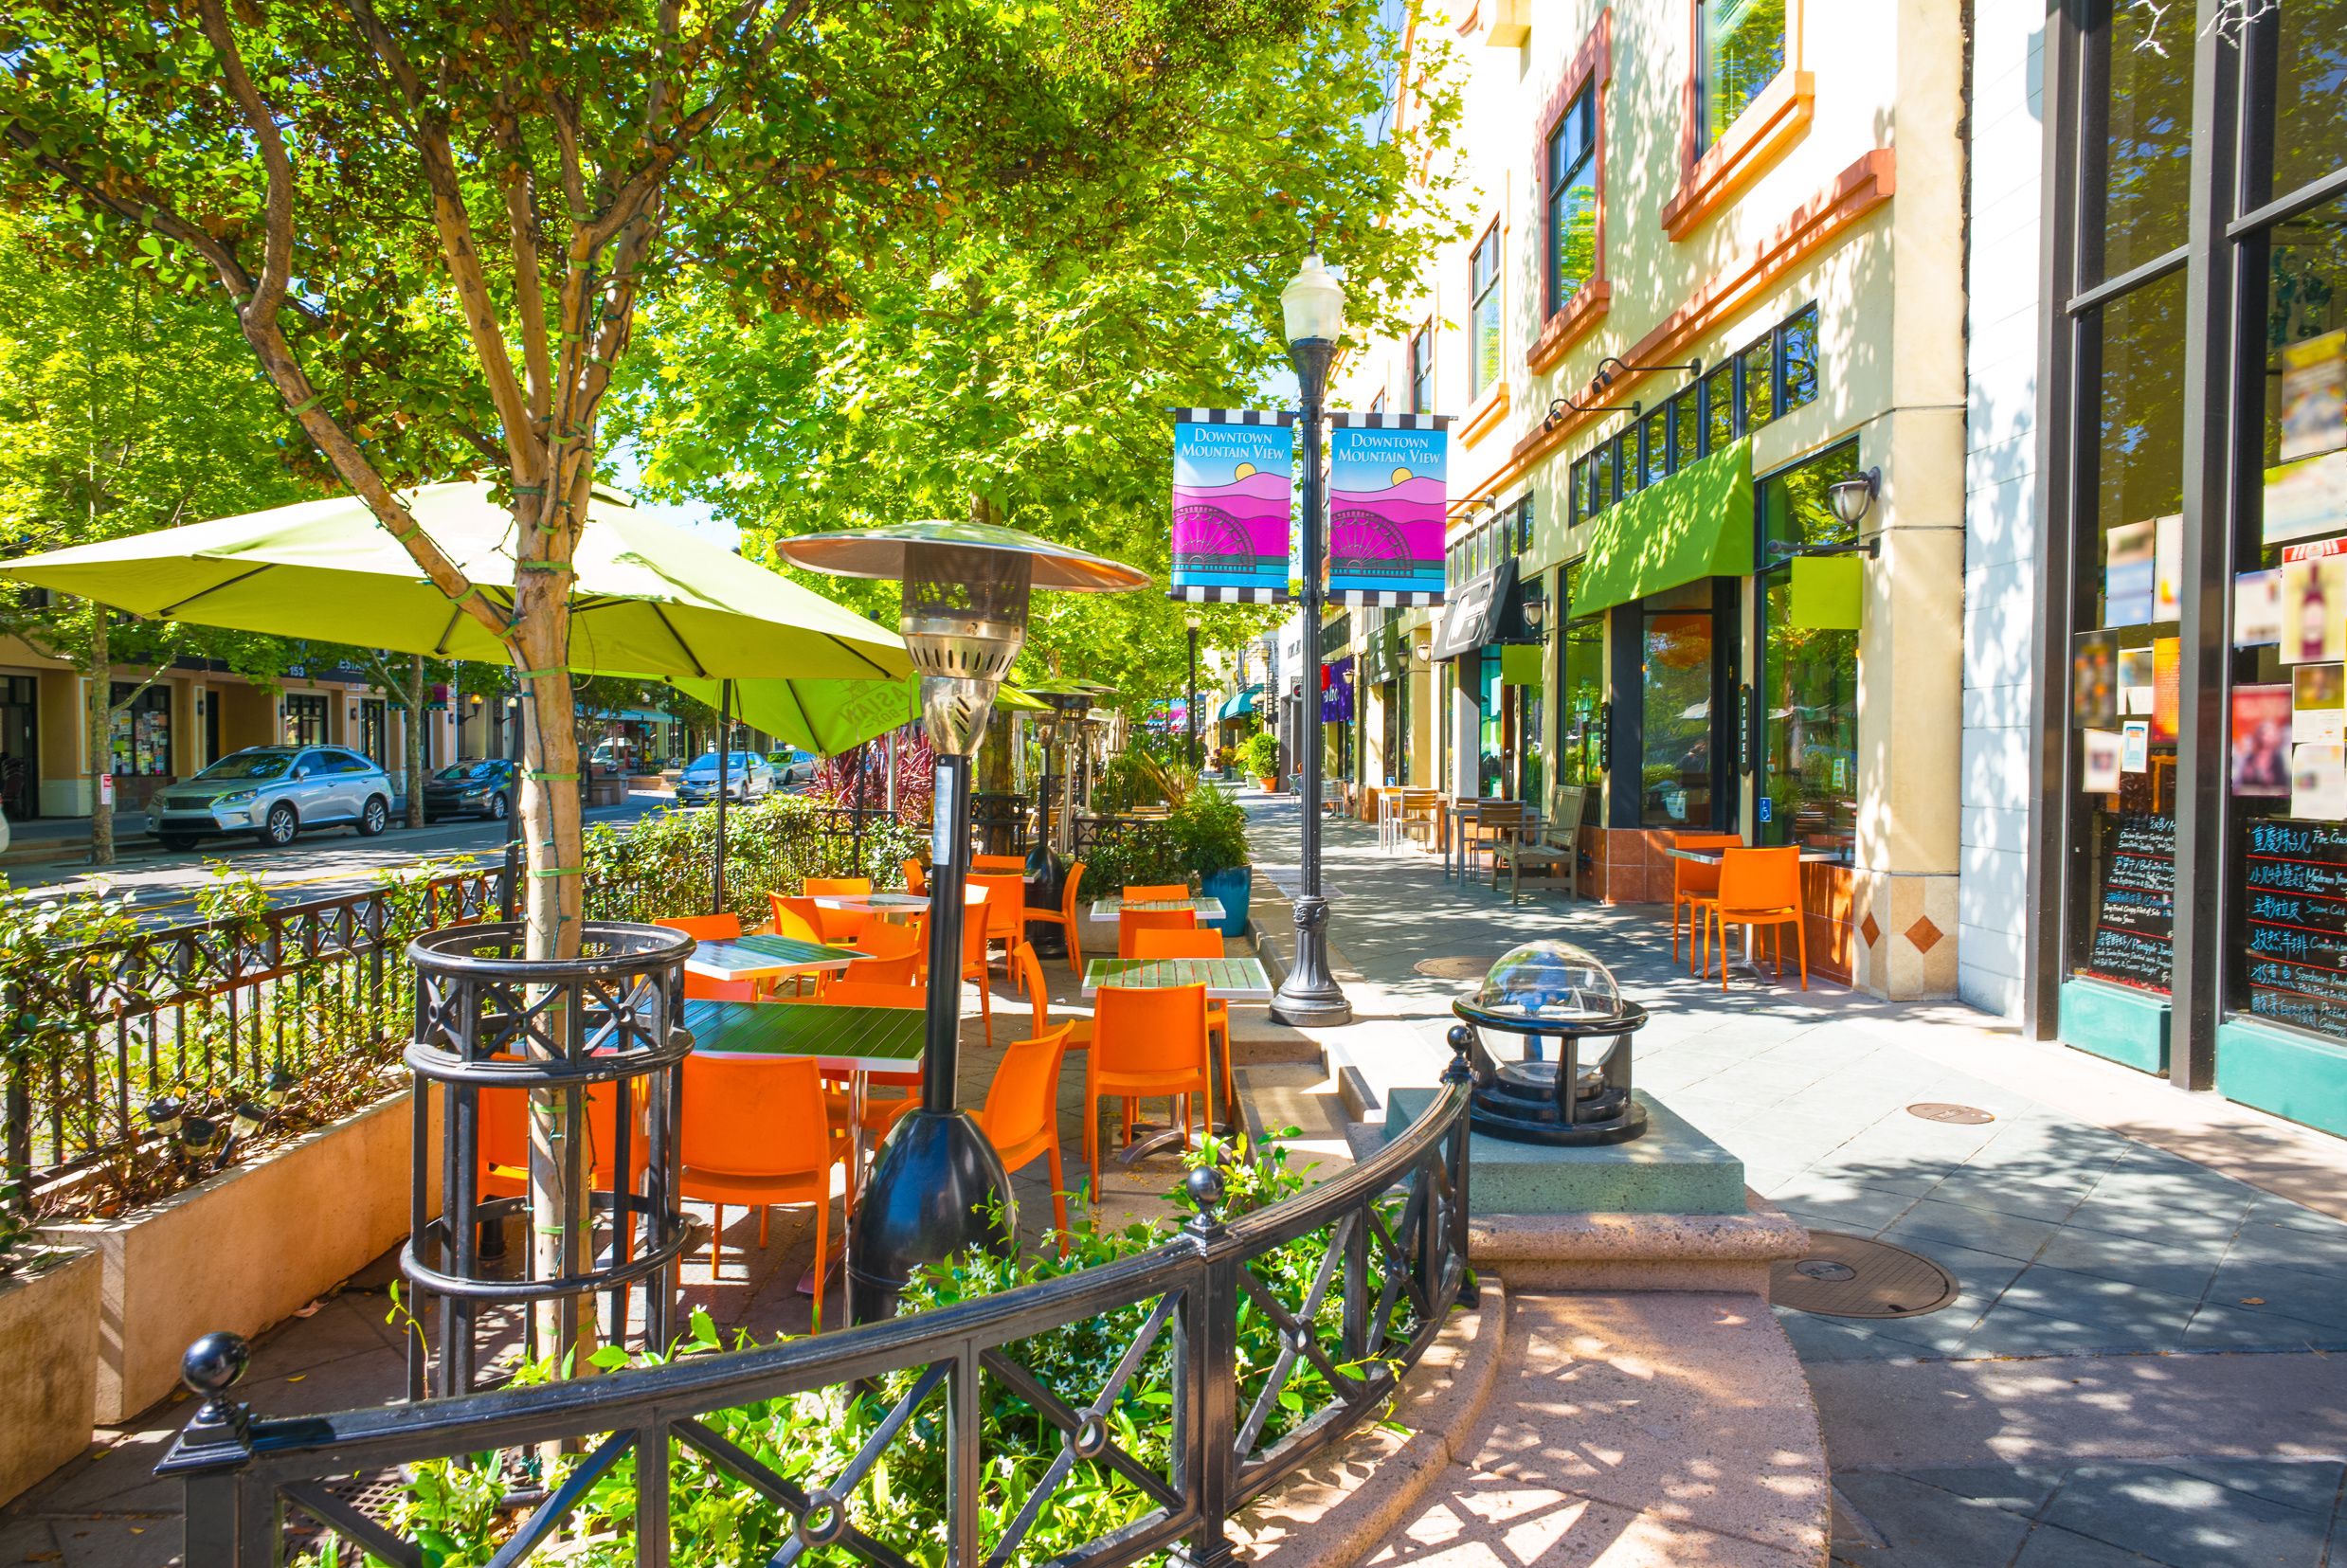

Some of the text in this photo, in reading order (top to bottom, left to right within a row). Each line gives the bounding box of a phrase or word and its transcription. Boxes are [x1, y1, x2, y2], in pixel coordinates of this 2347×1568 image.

[1194, 427, 1273, 444] DOWNTOWN
[1351, 433, 1429, 449] DOWNTOWN
[1182, 442, 1285, 460] MOUNTAIN VIEW
[1338, 448, 1440, 465] MOUNTAIN VIEW
[289, 665, 304, 677] 153
